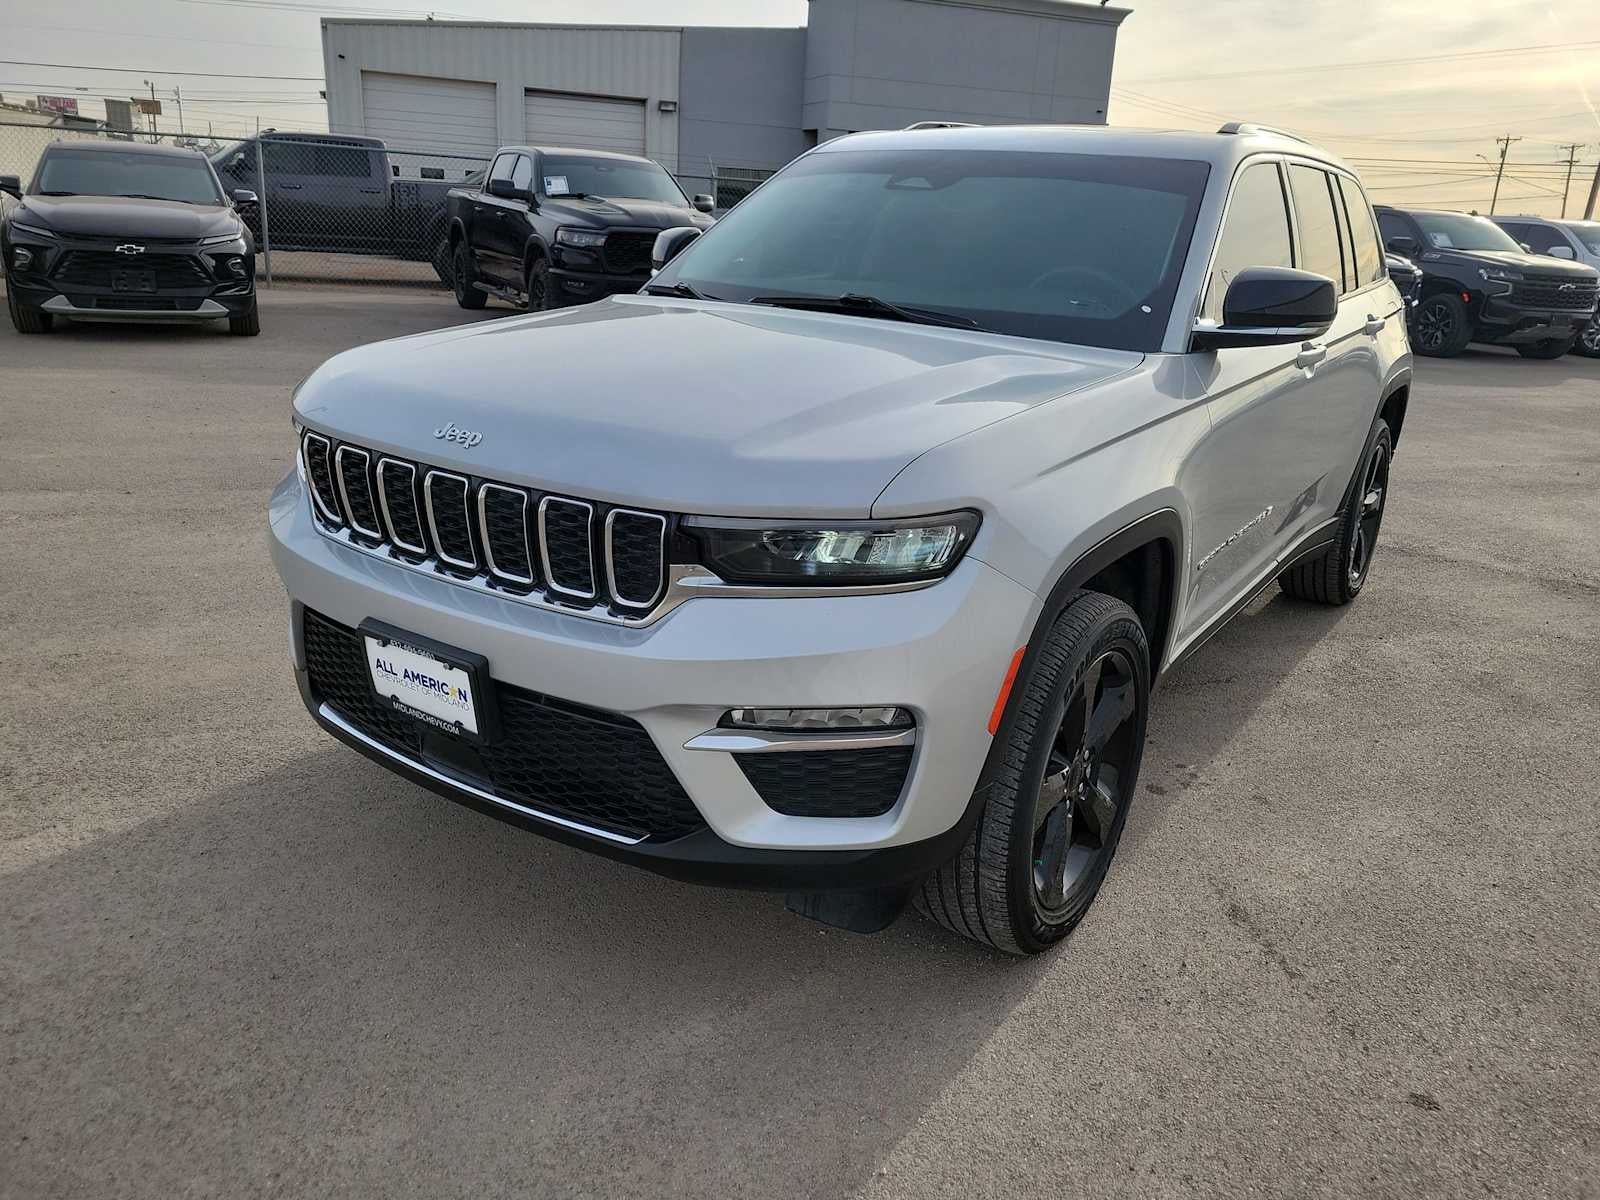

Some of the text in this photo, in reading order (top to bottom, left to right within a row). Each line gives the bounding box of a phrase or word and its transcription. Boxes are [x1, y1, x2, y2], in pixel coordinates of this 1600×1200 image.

[433, 422, 483, 450] Jeep
[376, 658, 468, 703] ALL AMERICN
